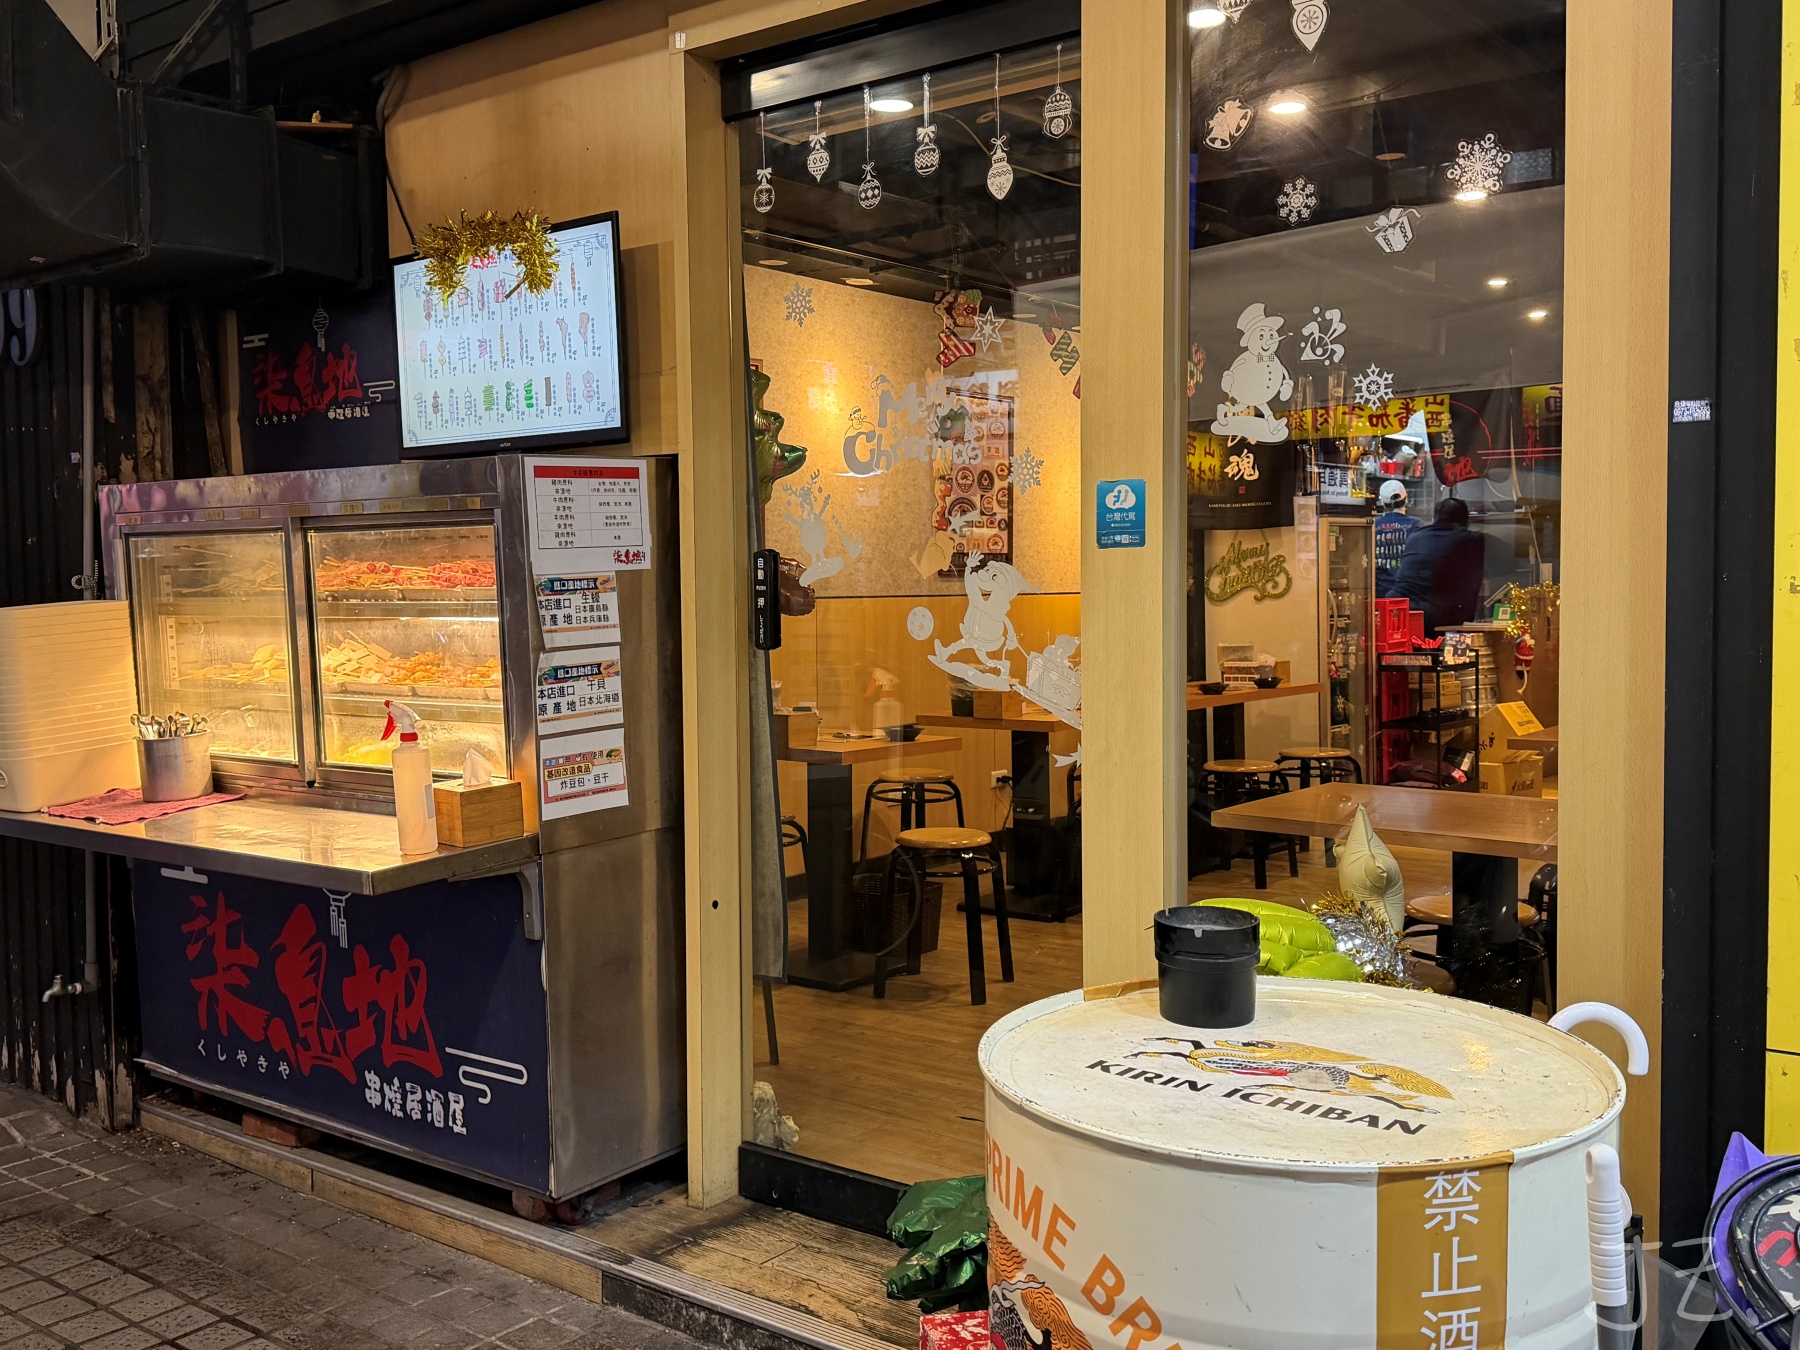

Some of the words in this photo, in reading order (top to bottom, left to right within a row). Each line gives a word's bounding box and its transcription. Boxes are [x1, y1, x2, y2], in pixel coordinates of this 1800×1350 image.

[255, 413, 298, 426] くしやきや
[553, 579, 595, 591] 進口產地標示
[538, 597, 572, 611] 本店進口
[581, 591, 601, 604] 生蠔
[575, 603, 609, 614] 日本廣島縣
[575, 614, 610, 625] 日本兵庫縣
[557, 664, 599, 678] 進口產地標示
[587, 678, 606, 691] 干貝
[538, 684, 575, 700] 本店進口
[579, 692, 620, 707] 日本北海道
[538, 700, 577, 717] 原產地
[591, 750, 604, 760] 使用
[546, 763, 591, 779] 基因改造食品
[560, 772, 609, 790] 炸豆包、豆干
[197, 1038, 290, 1080] くしやきや
[364, 1069, 467, 1135] 串燒居酒屋
[1085, 1059, 1214, 1093] KIRIN
[1221, 1087, 1427, 1136] ICHIBAN
[985, 1129, 1077, 1272] PRIME
[1080, 1252, 1183, 1350] BR
